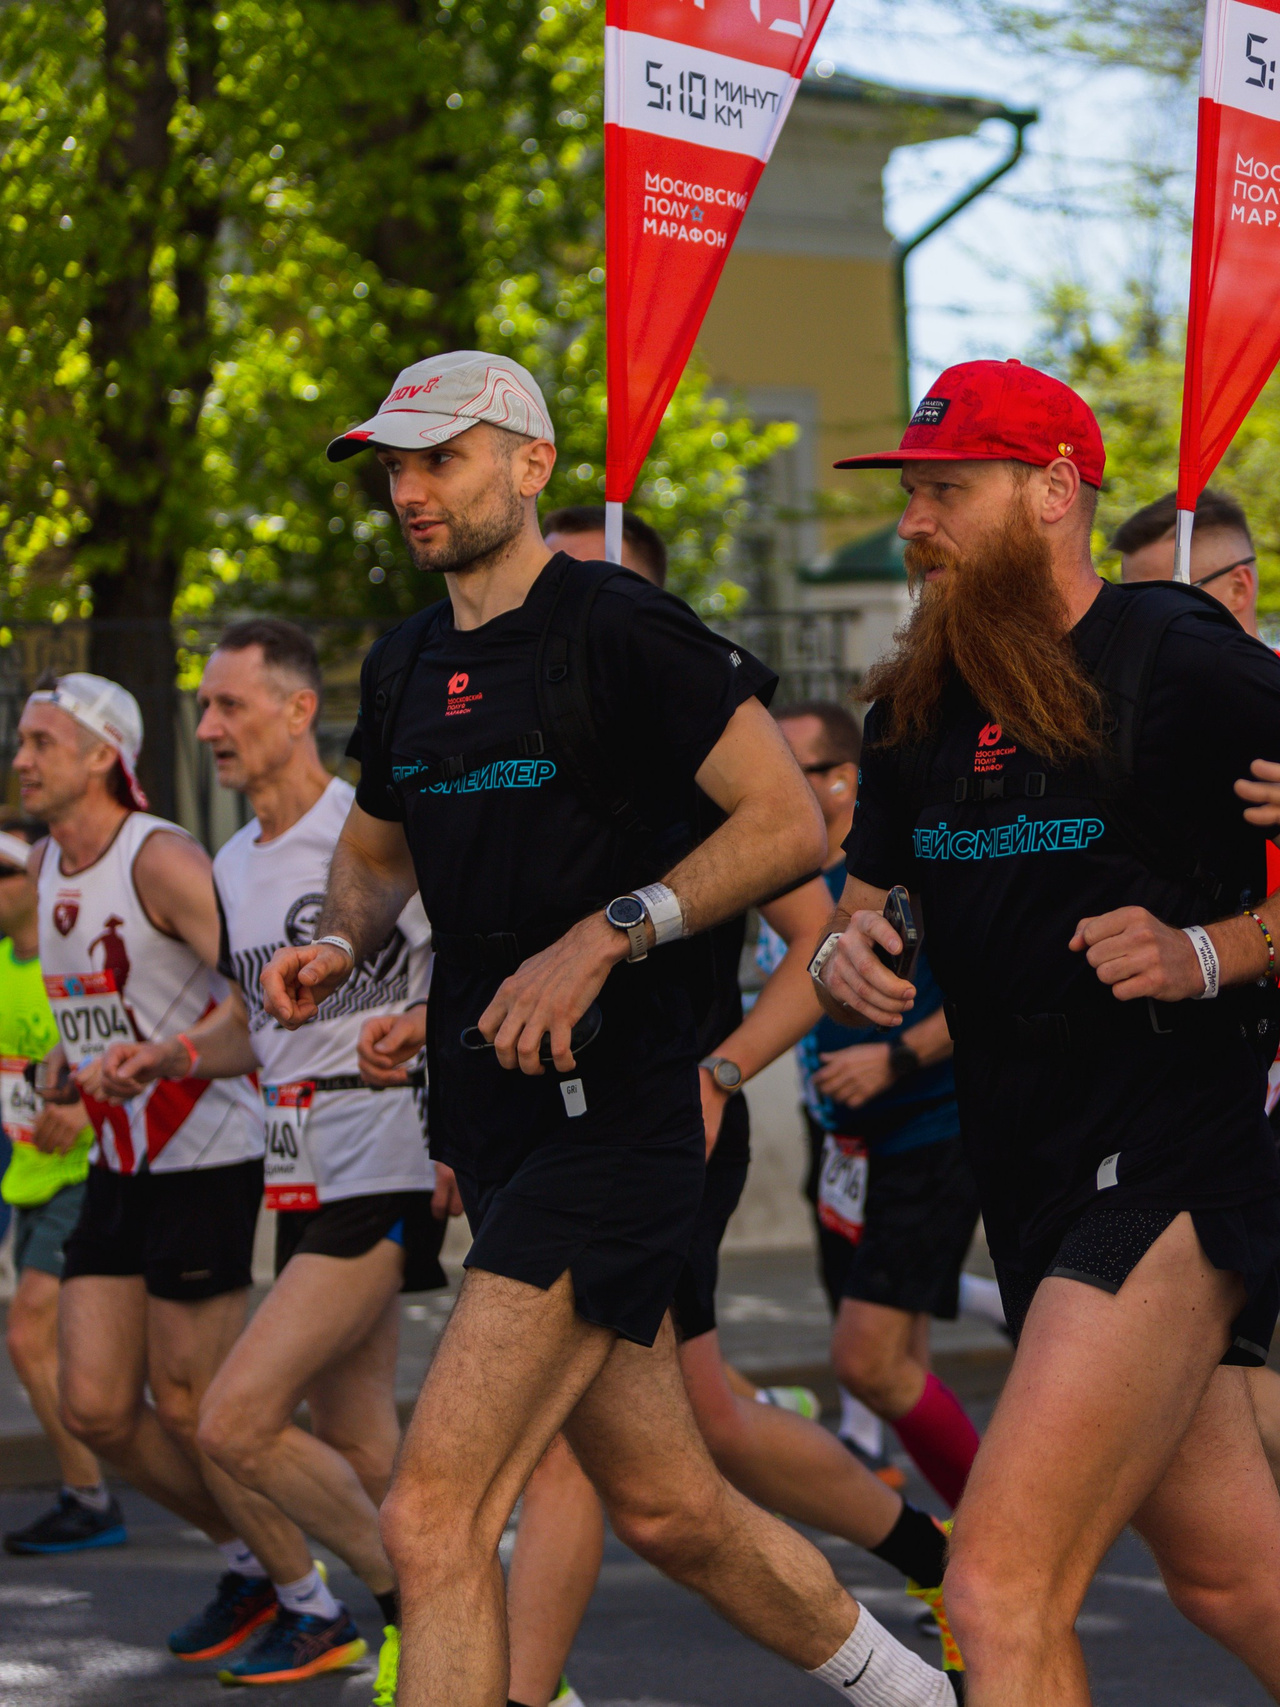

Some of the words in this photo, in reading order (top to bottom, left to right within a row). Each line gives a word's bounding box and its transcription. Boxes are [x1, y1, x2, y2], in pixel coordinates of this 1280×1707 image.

[645, 60, 706, 120] 5:10
[714, 103, 743, 129] КМ
[644, 170, 748, 211] МОСКОВСКИЙ
[643, 195, 690, 219] ПОЛУ
[643, 217, 728, 249] МАРАФОН
[447, 692, 483, 705] МОСКОВСКИЙ
